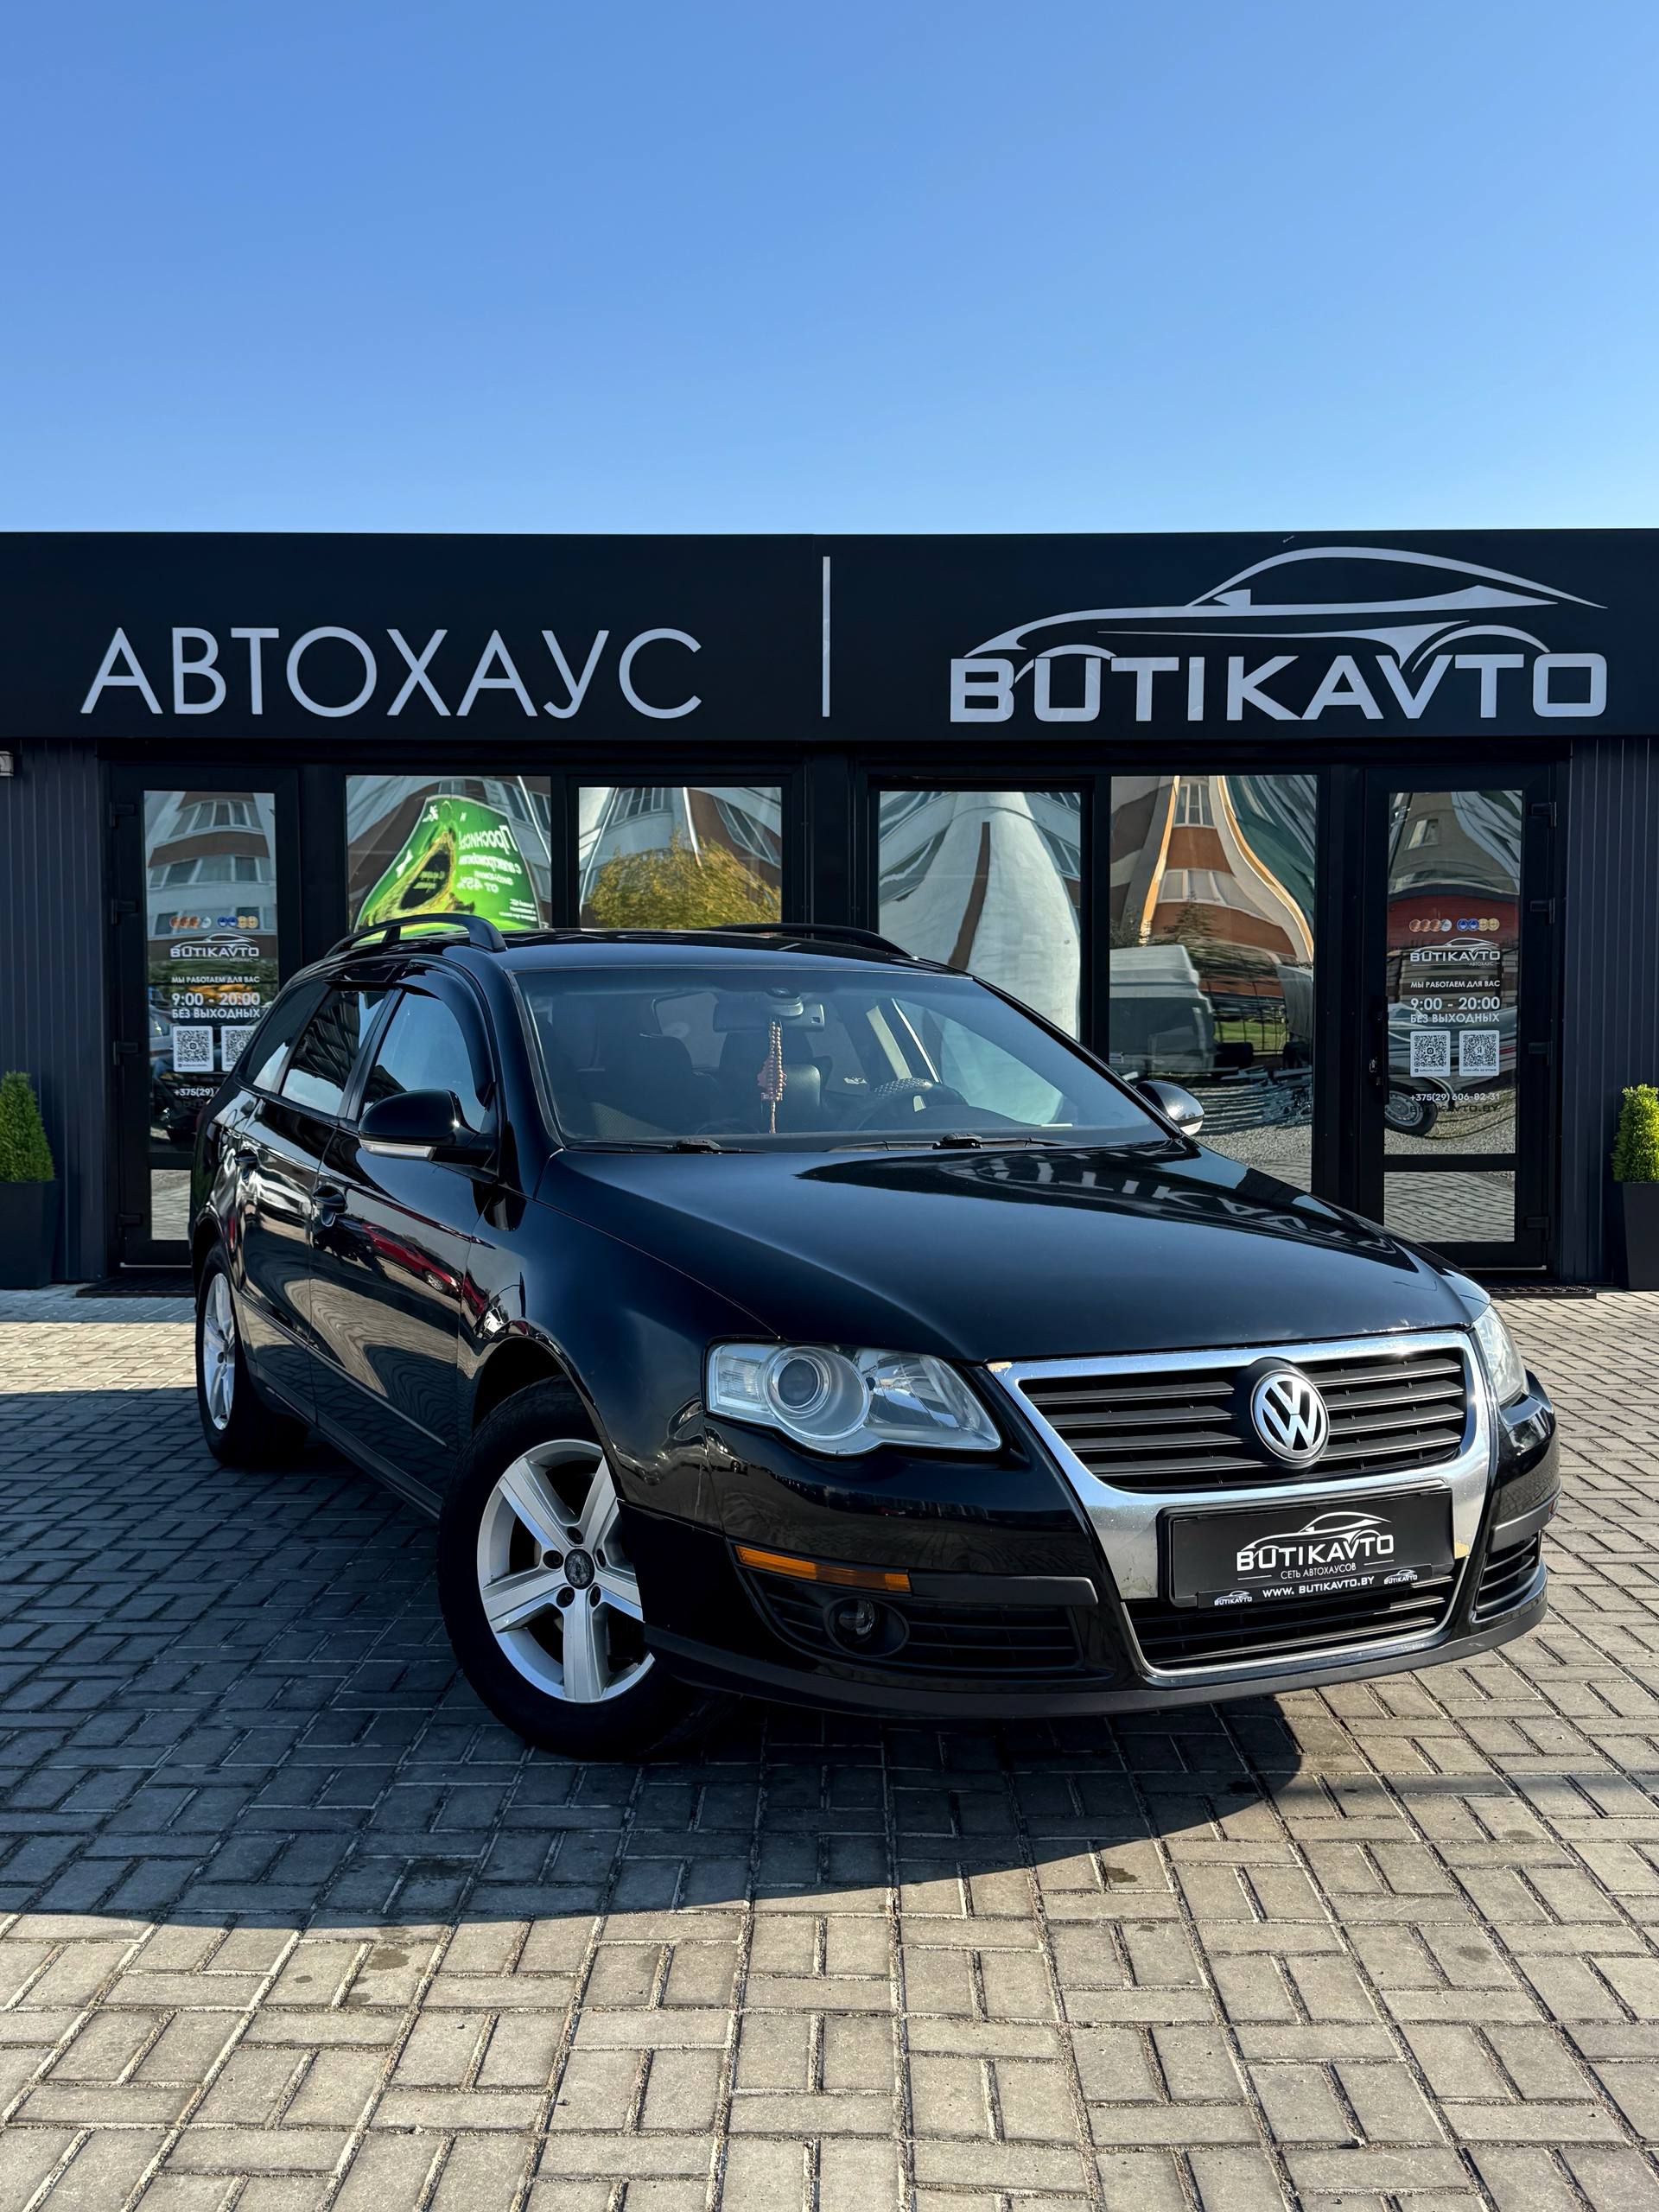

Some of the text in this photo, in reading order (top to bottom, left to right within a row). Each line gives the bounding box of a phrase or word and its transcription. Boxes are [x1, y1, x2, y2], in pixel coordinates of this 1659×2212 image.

[80, 626, 702, 719] АВТОХАУС
[950, 652, 1608, 723] BUTIKAVTO
[170, 946, 259, 957] BUTIKAVTO
[1410, 951, 1501, 962] BUTIKAVTO
[171, 993, 204, 1006] 9:00
[219, 992, 260, 1006] 20:00
[1410, 997, 1442, 1010] 9:00
[1458, 996, 1501, 1009] 20:00
[173, 1007, 260, 1019] БЕЗ ВЫХОДНЫХ
[1410, 1013, 1500, 1023] БЕЗ ВЫХОДНЫХ
[174, 1087, 213, 1097] +375(29)
[1410, 1092, 1500, 1103] +375(29) 606-82-31
[1236, 1535, 1395, 1572] BUTIKAVTO
[1281, 1562, 1357, 1580] СЕТЬ АВТОХАУСОВ
[1384, 1574, 1418, 1585] BUTIKAVTO
[1262, 1576, 1375, 1599] WWW. BUTIKAVTO.BY
[1214, 1596, 1253, 1606] BUTIKAVTO
